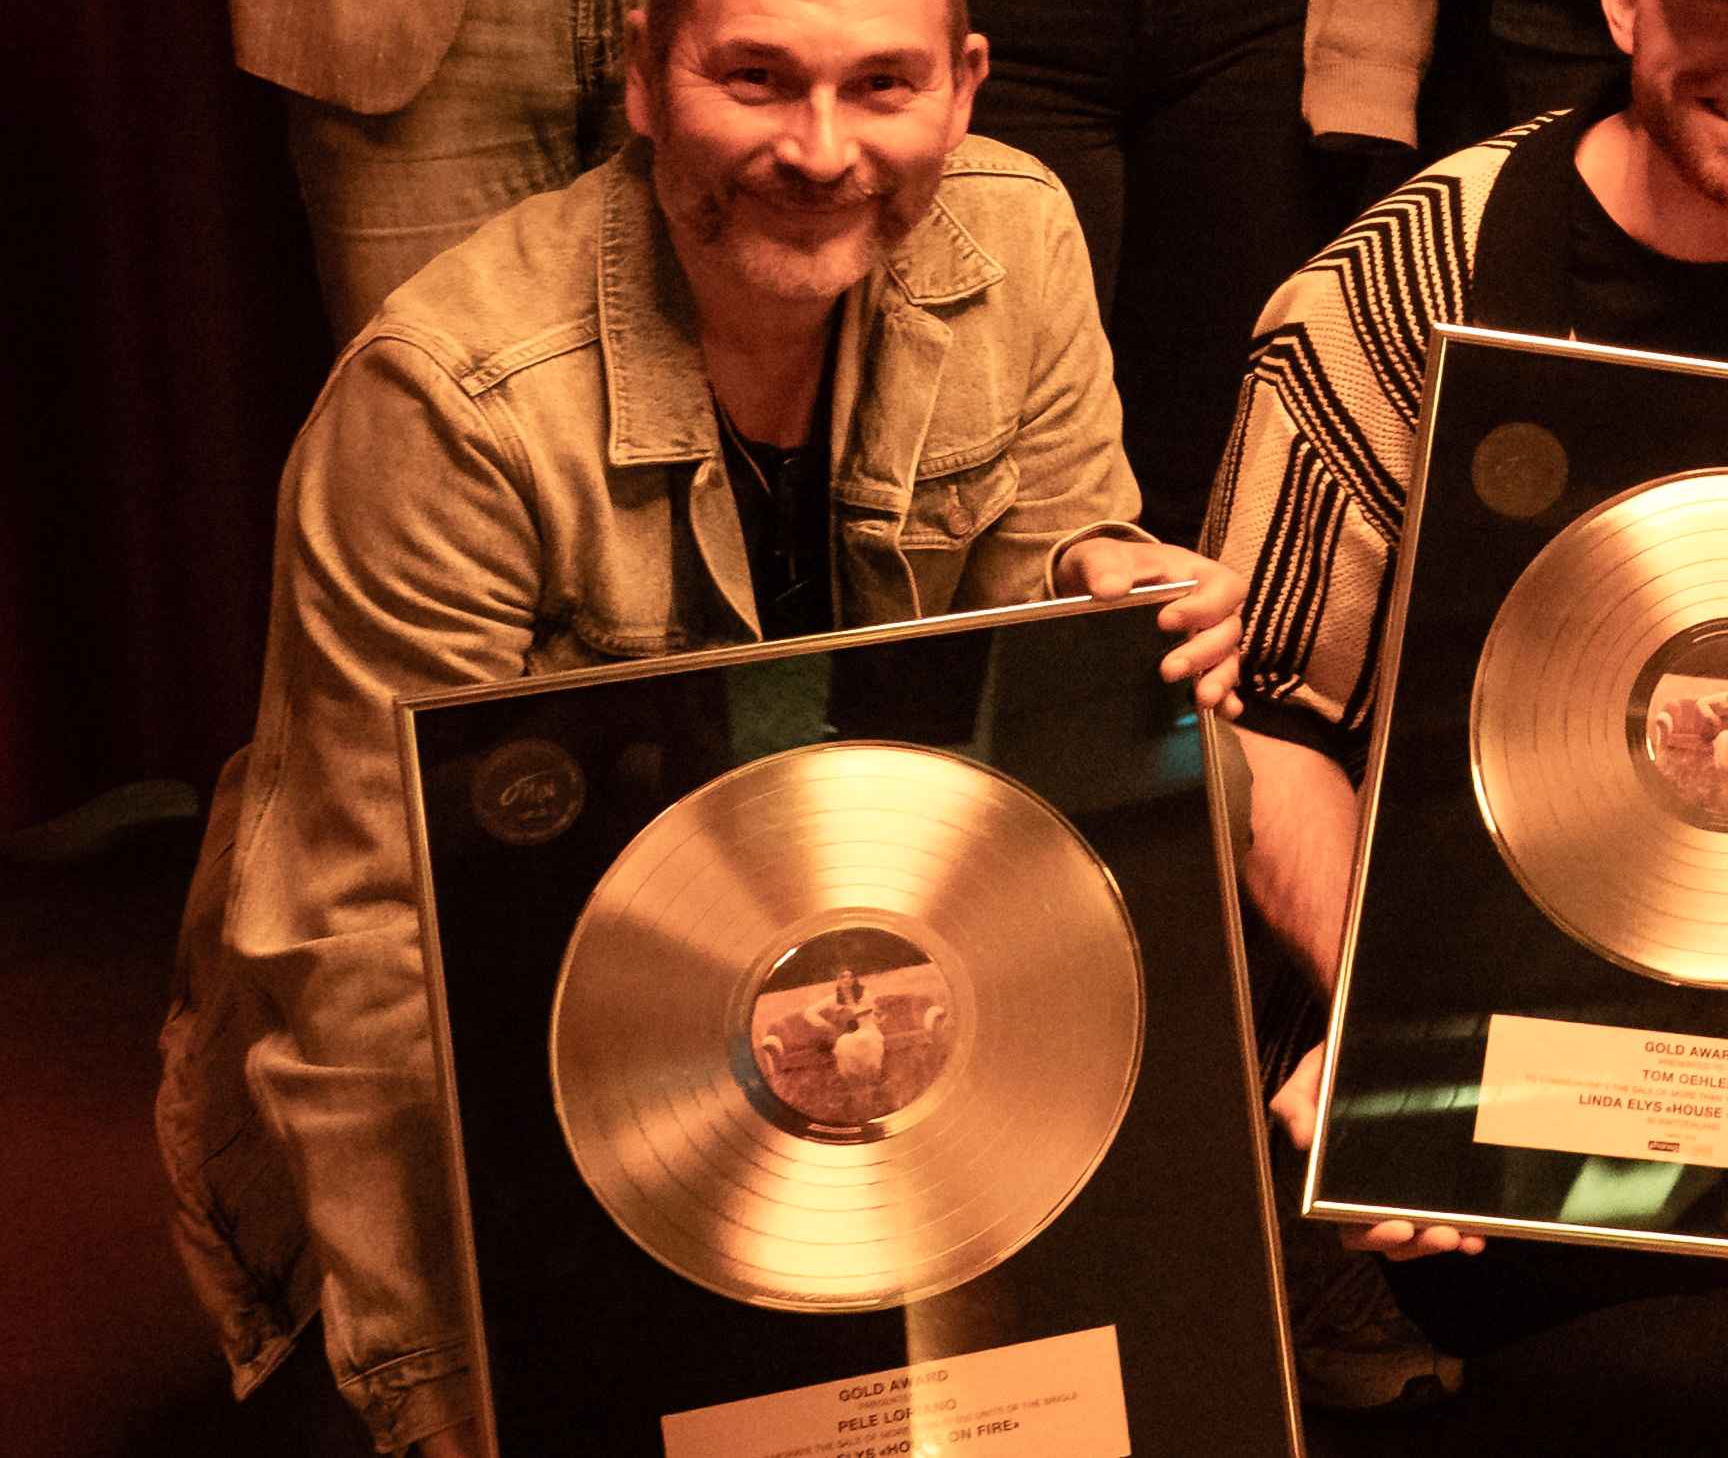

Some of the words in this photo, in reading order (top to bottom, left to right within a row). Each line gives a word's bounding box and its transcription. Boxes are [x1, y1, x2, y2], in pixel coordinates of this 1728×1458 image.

[1644, 1041, 1685, 1055] GOLD
[1642, 1069, 1675, 1083] TOM
[1579, 1093, 1622, 1108] LINDA
[1627, 1098, 1663, 1112] ELYS
[838, 1383, 884, 1402] GOLD
[838, 1414, 878, 1433] PELE
[884, 1398, 957, 1424] LOANO
[949, 1428, 972, 1443] ON
